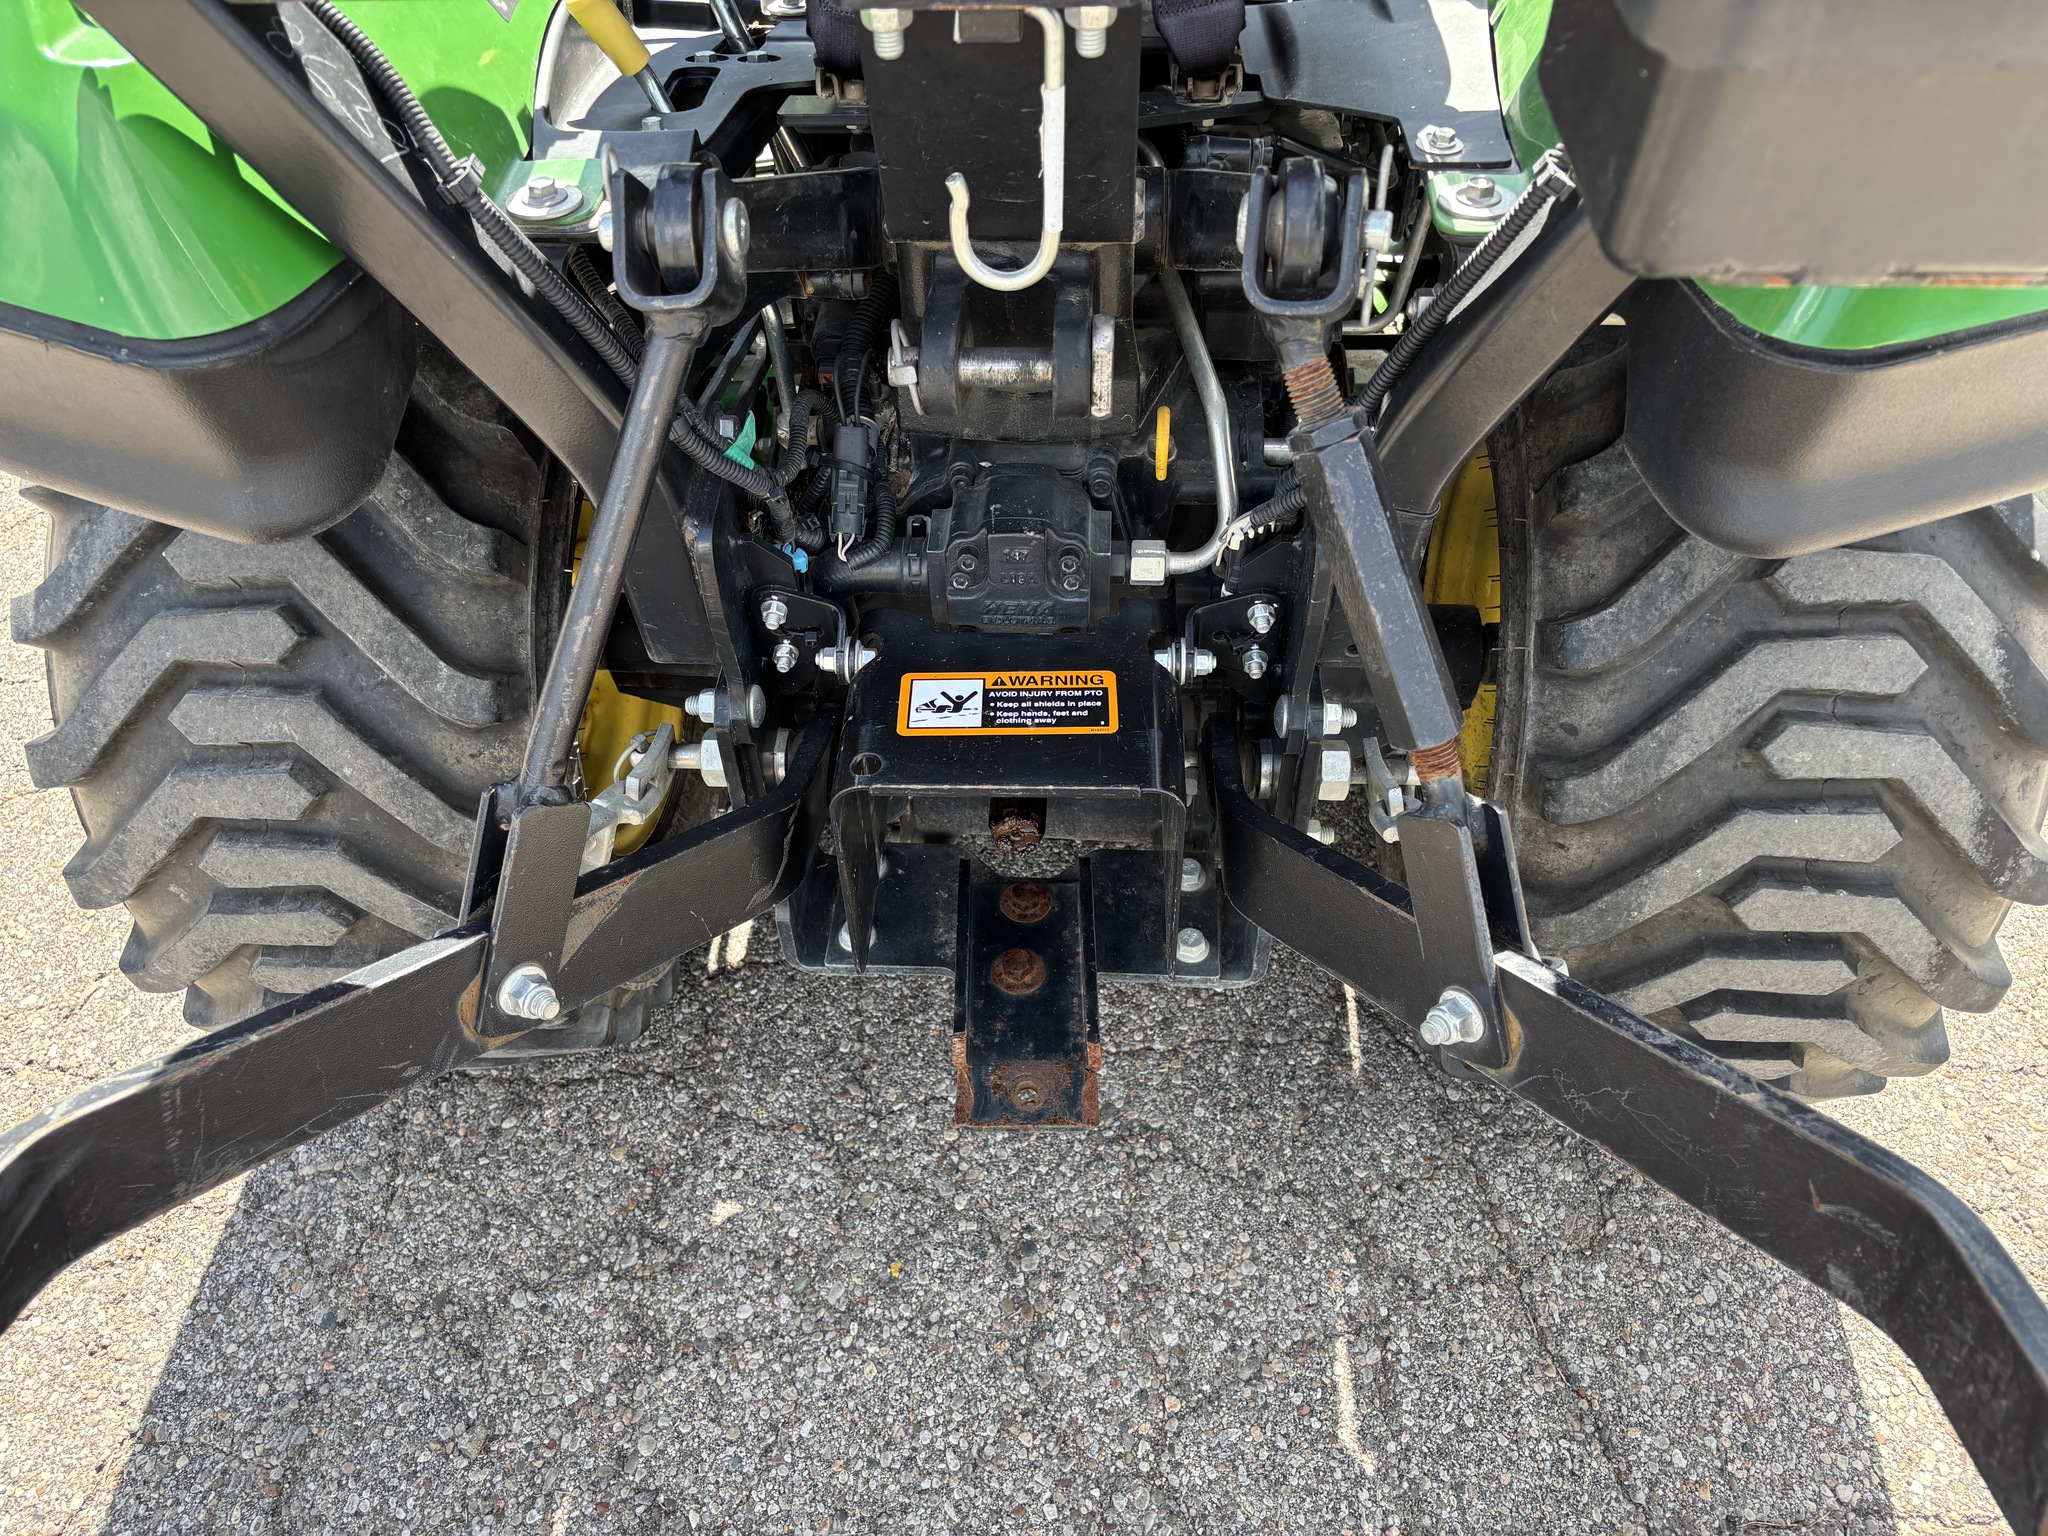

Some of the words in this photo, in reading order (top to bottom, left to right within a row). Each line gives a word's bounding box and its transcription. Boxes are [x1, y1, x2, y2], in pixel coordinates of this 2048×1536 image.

[1008, 674, 1105, 686] WARNING
[996, 710, 1019, 718] Keep
[995, 717, 1033, 725] clothing
